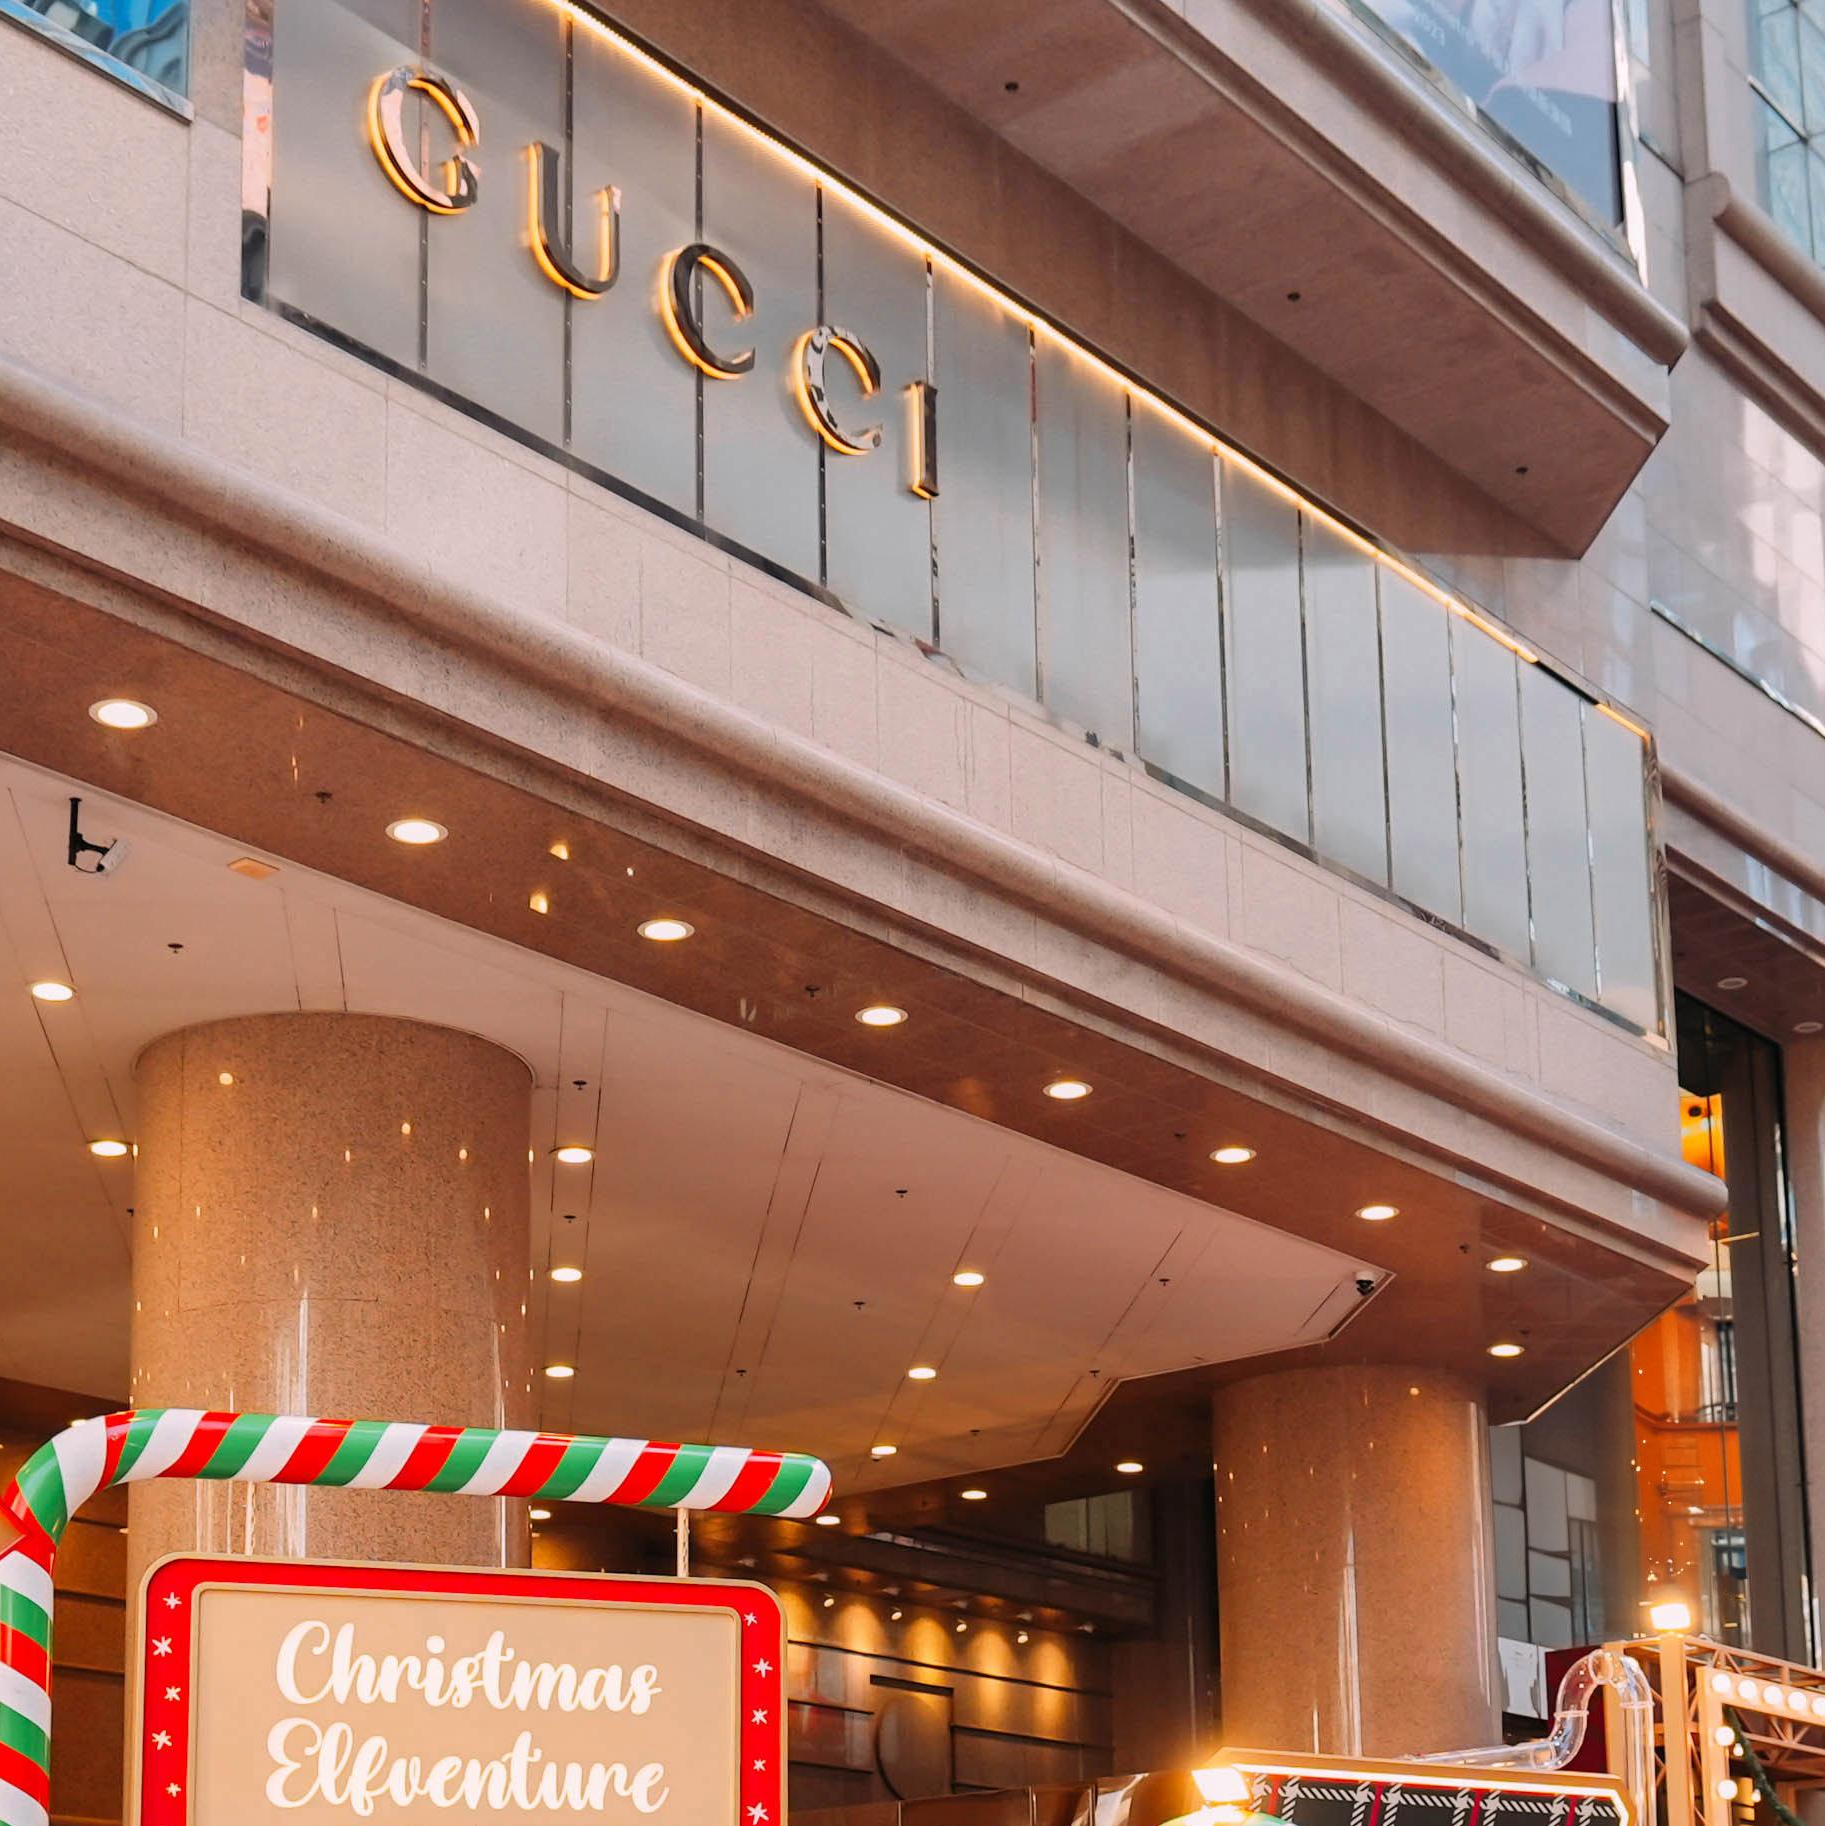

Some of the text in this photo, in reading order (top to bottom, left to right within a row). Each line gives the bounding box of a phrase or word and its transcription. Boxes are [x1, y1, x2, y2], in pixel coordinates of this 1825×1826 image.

[368, 64, 940, 500] GUCCI
[274, 1620, 663, 1715] Christmas
[265, 1717, 670, 1817] Elfventure
